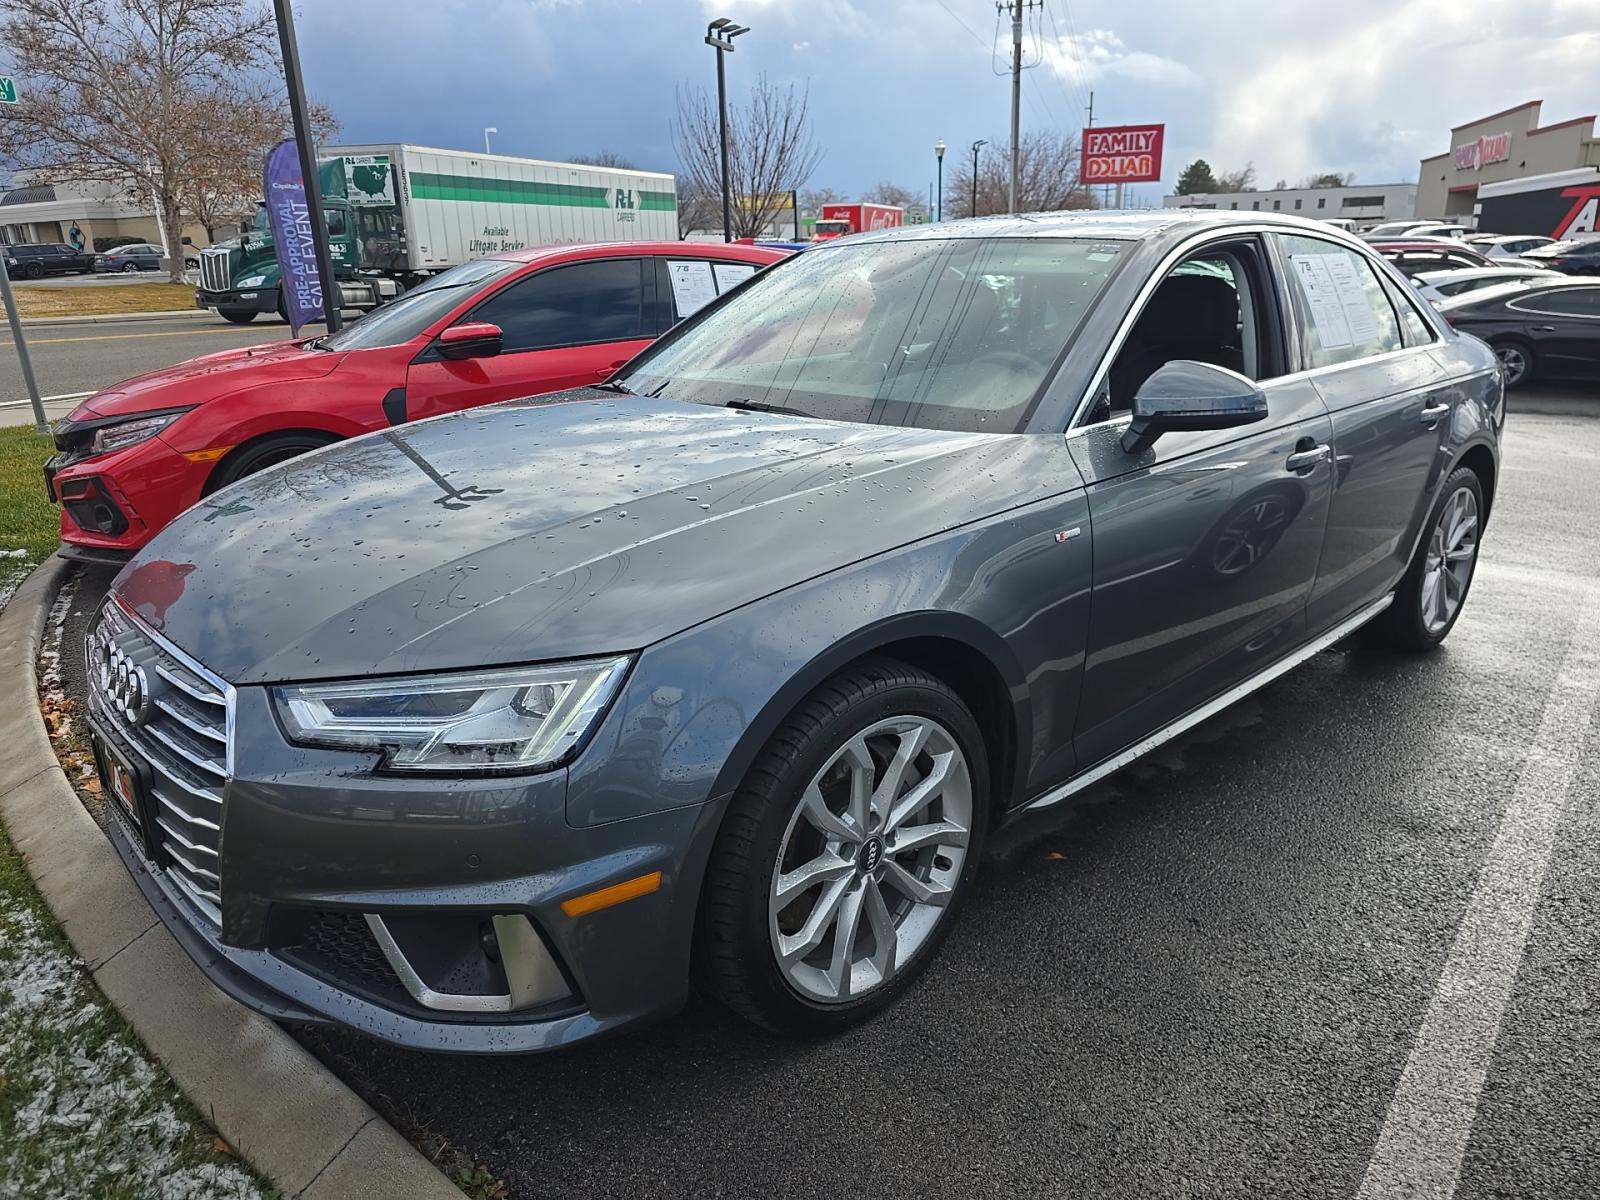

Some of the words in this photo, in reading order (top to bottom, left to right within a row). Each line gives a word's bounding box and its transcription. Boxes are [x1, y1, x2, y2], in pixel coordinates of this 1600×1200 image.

[1088, 131, 1158, 154] FAMILY
[1086, 154, 1152, 178] DOLLAR
[291, 202, 317, 258] EVENT
[483, 226, 509, 237] Available
[279, 201, 312, 309] PRE-APPROVAL
[469, 239, 498, 255] Liftgate
[500, 238, 525, 252] Service
